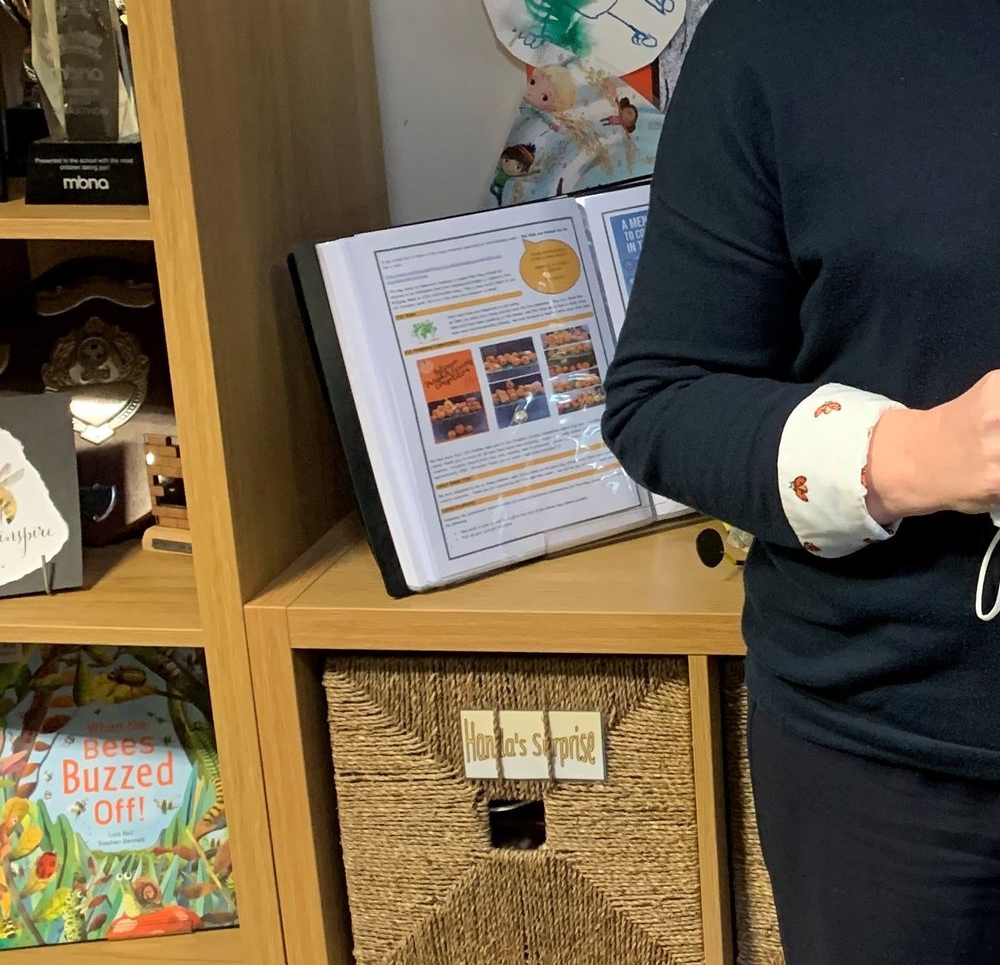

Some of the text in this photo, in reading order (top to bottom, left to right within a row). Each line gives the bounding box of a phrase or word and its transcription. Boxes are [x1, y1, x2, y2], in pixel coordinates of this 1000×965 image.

[63, 175, 109, 190] mbna
[622, 219, 628, 230] A
[624, 231, 634, 242] TO
[626, 242, 636, 253] IN
[83, 736, 155, 760] Bees
[62, 749, 174, 794] Buzzed
[94, 796, 144, 826] Off!
